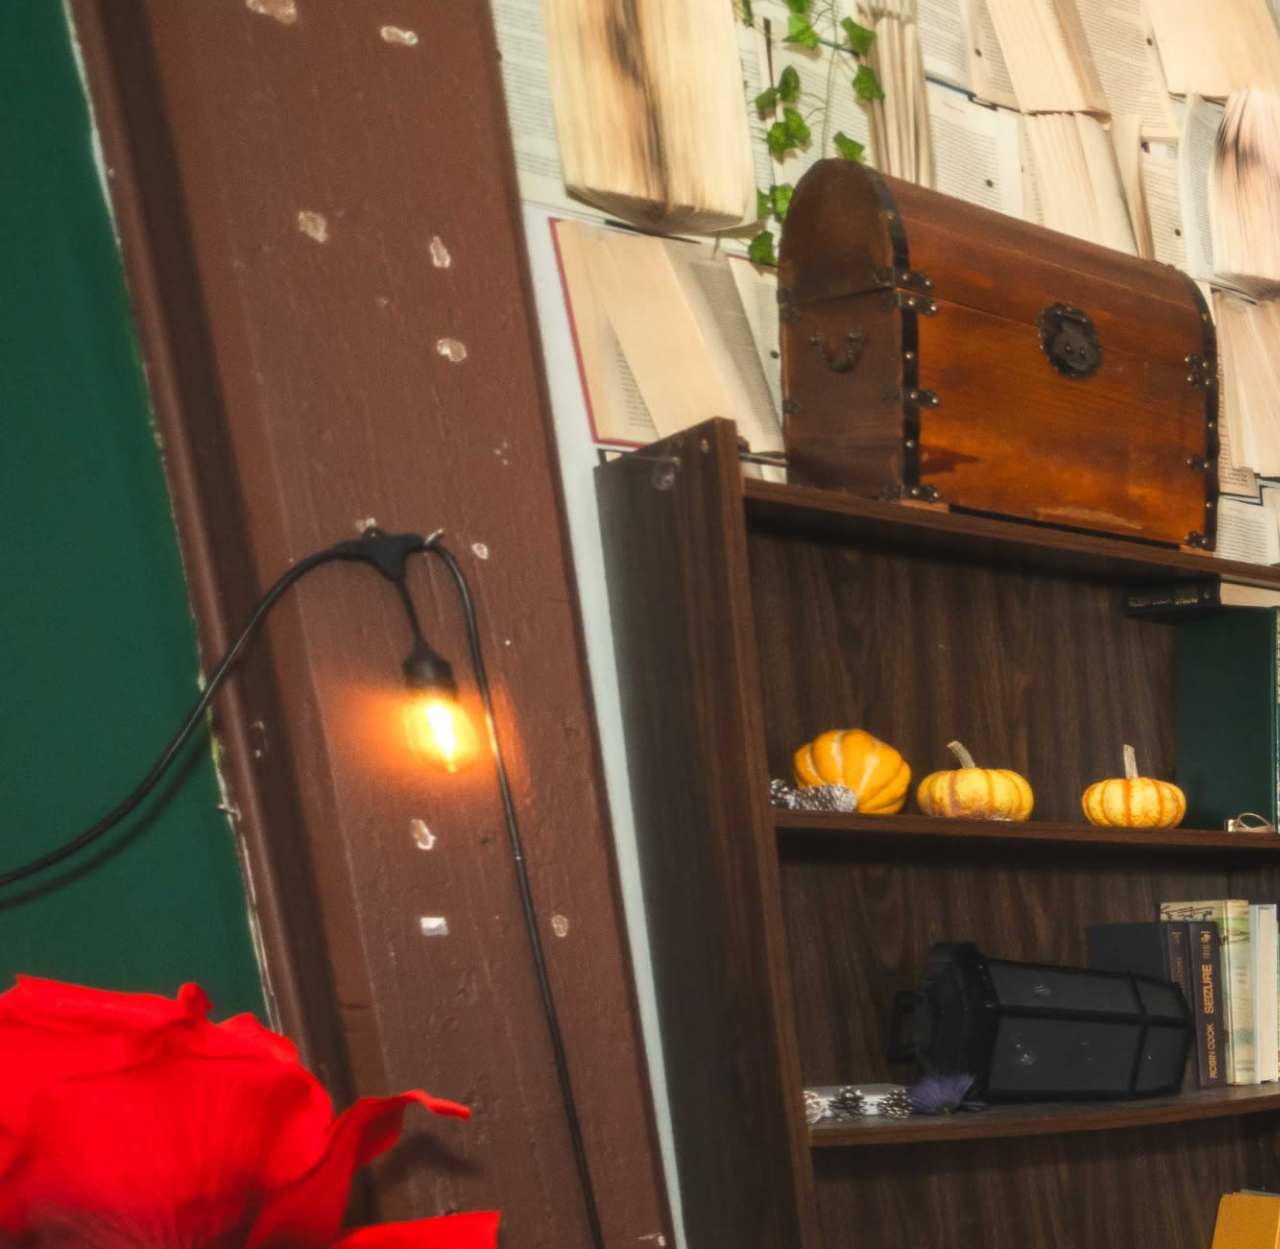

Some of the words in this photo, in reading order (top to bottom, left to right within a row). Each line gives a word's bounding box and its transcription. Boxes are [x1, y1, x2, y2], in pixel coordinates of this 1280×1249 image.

[1202, 964, 1214, 1014] SEIZURE
[1207, 1023, 1215, 1050] COOK
[1208, 1051, 1217, 1079] ROBIN
